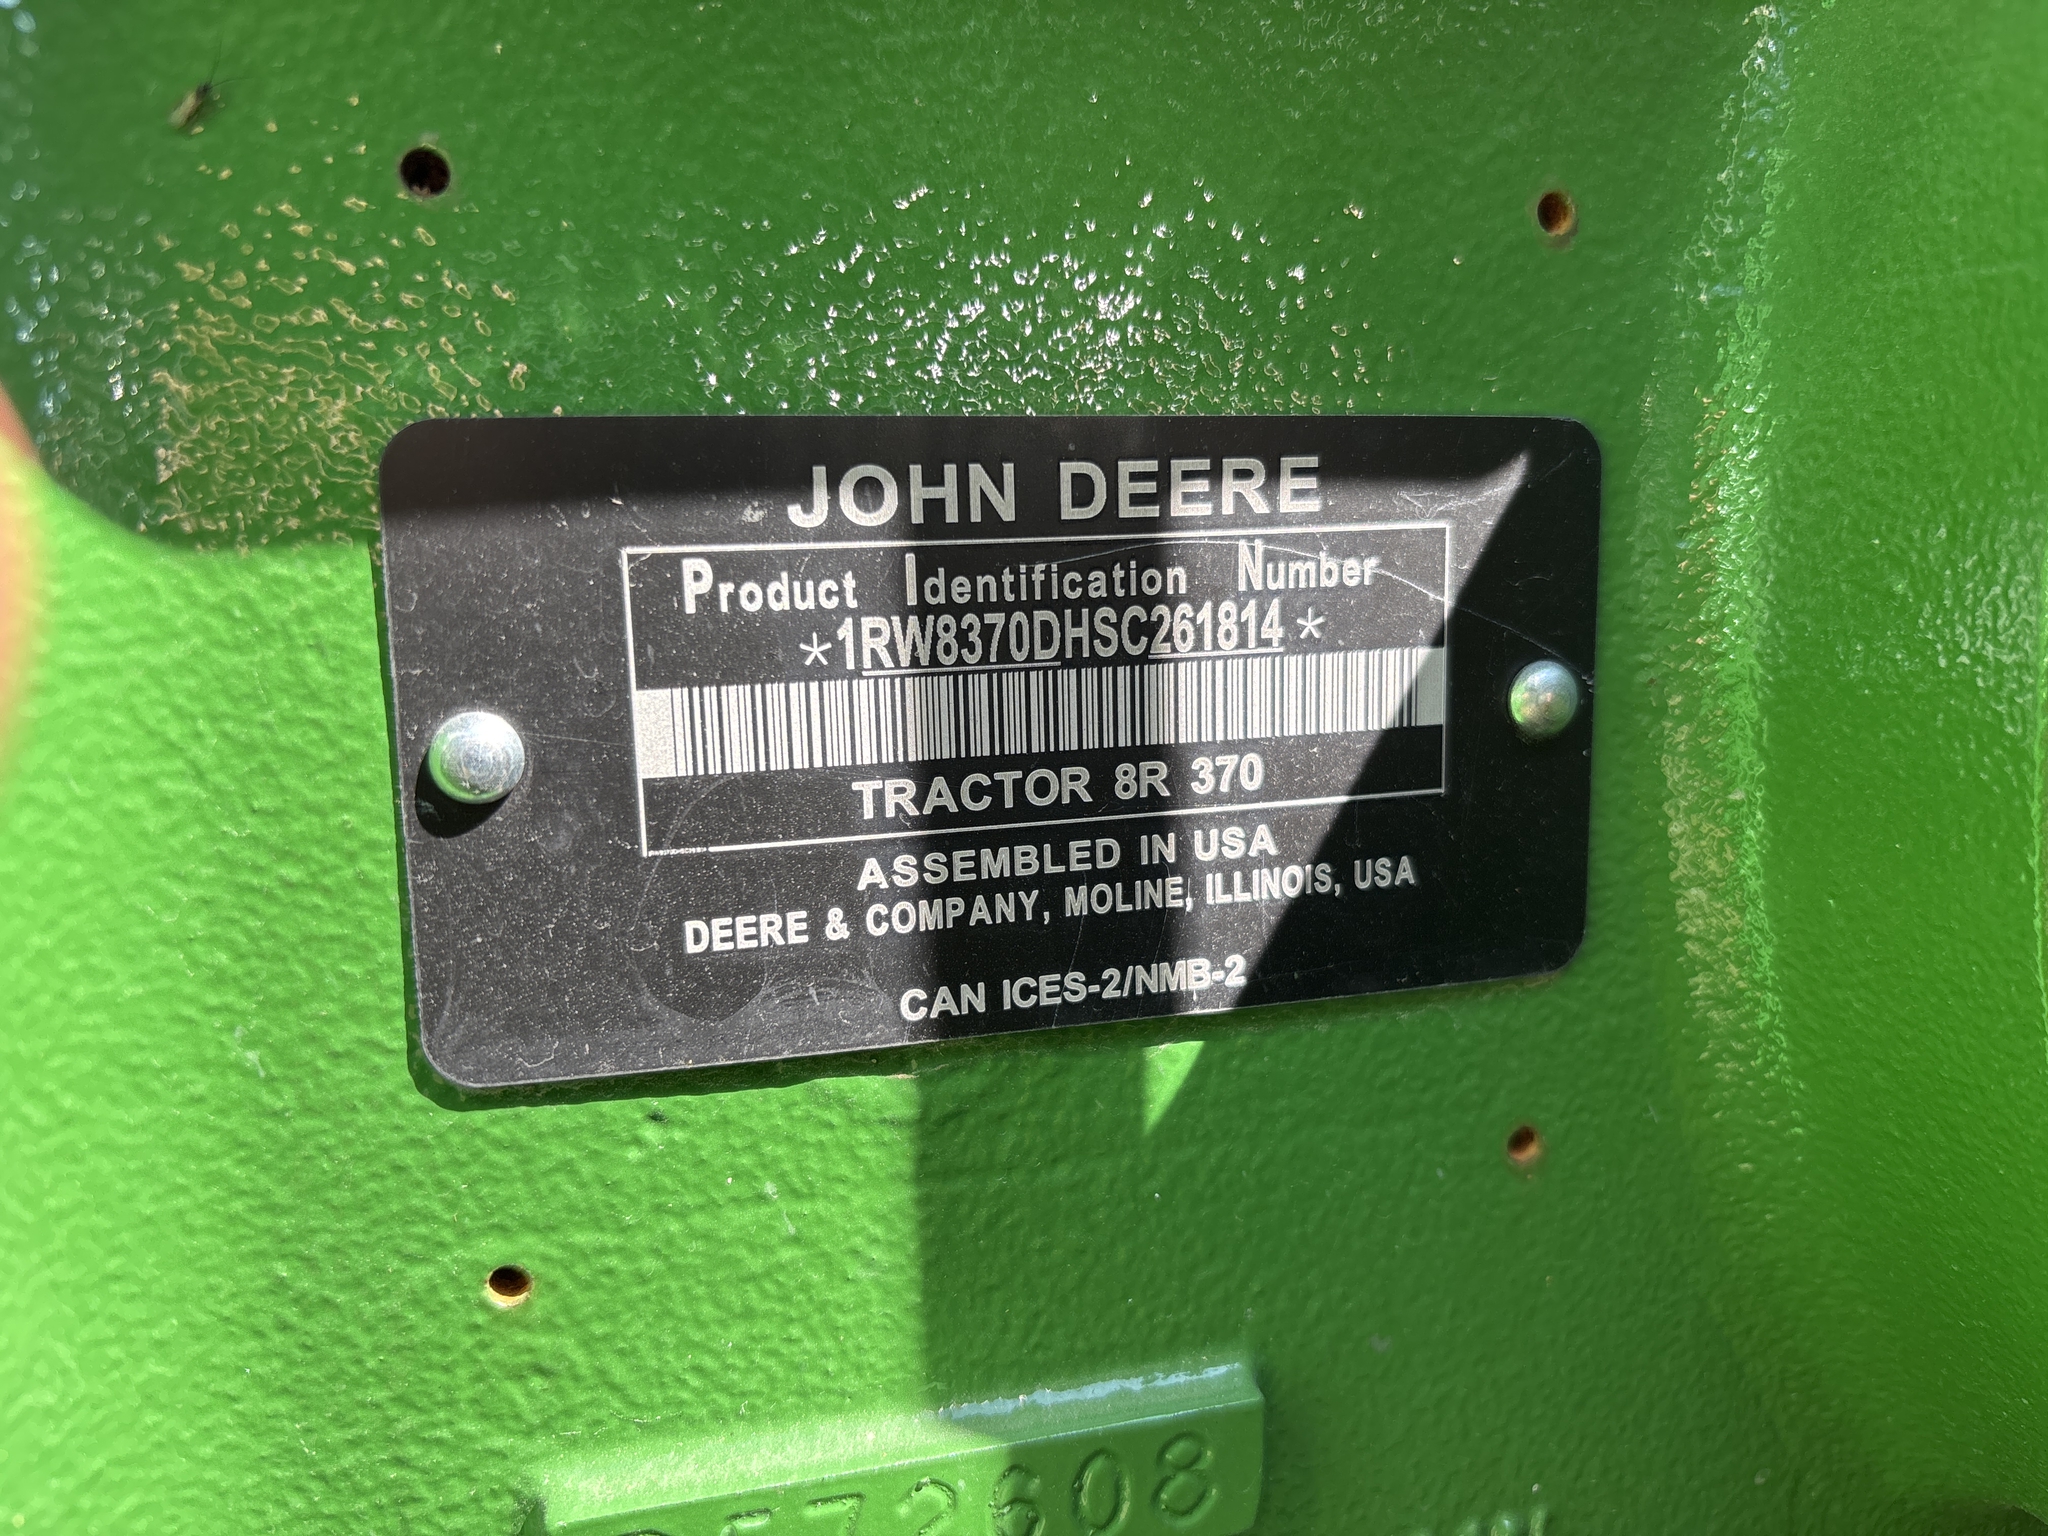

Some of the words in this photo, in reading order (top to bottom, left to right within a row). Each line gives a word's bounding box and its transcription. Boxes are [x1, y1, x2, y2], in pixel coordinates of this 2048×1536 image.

[787, 462, 1016, 528] JOHN
[1059, 456, 1321, 520] DEERE
[681, 557, 859, 614] Product
[905, 552, 1187, 606] Identification
[1237, 538, 1378, 592] Number
[851, 767, 1093, 820] TRACTOR
[1114, 761, 1171, 800] 8R
[1190, 752, 1264, 795] 370
[857, 837, 1120, 891] ASSEMBLED
[1140, 832, 1176, 865] IN
[1193, 823, 1278, 862] USA
[684, 910, 809, 954] DEERE
[824, 907, 850, 941] &
[865, 890, 1050, 937] COMPANY,
[1064, 876, 1194, 917] MOLINE,
[1205, 864, 1343, 906] ILLINOIS,
[1354, 855, 1415, 890] USA
[900, 982, 986, 1022] CAN
[1002, 954, 1248, 1011] ICES-2/NMB-2
